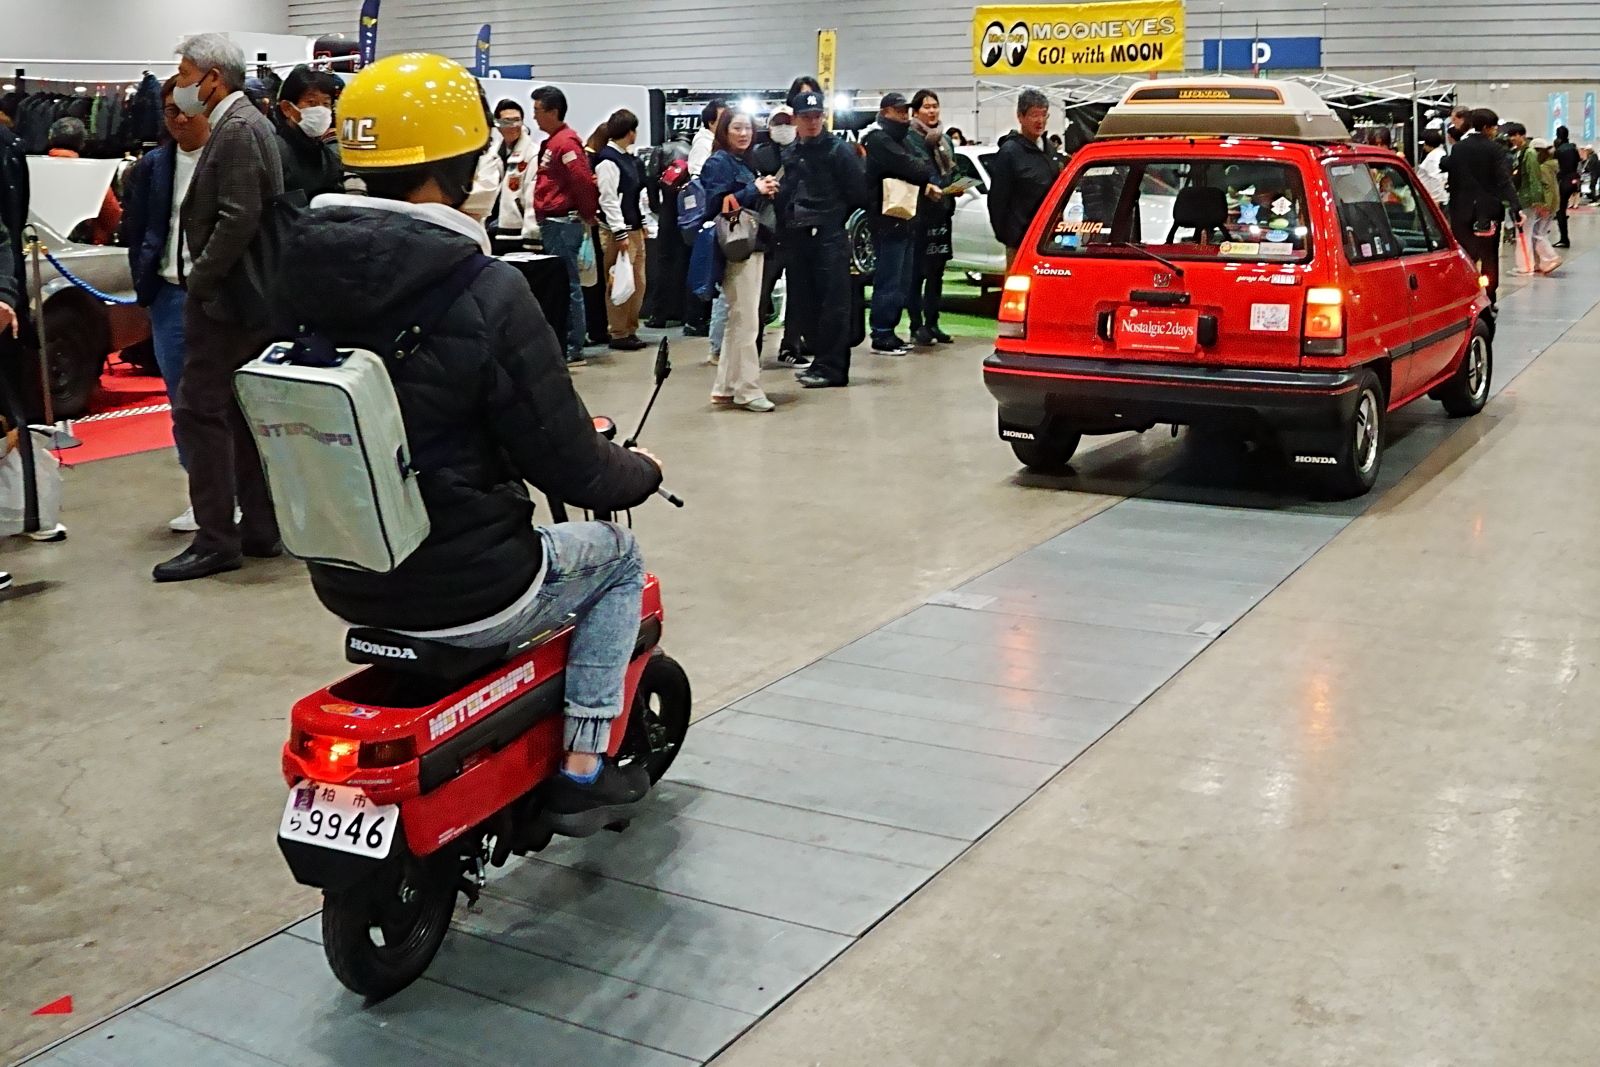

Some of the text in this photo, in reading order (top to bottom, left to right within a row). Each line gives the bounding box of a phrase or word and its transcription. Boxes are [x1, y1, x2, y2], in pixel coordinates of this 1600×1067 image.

[1032, 16, 1176, 41] MOONEYES
[1038, 42, 1164, 64] GO! with MOON
[1251, 42, 1272, 64] D
[1178, 90, 1231, 99] HONDA
[342, 117, 377, 143] MC
[1054, 221, 1104, 234] SHOWA
[1036, 268, 1072, 276] HONDA
[1121, 319, 1194, 339] Nostalgic 2days
[1002, 429, 1035, 441] HONDA
[1294, 455, 1338, 465] HONDA
[350, 637, 418, 660] HONDA
[428, 660, 536, 741] MOTOCOMPO
[289, 809, 386, 849] ら 9946
